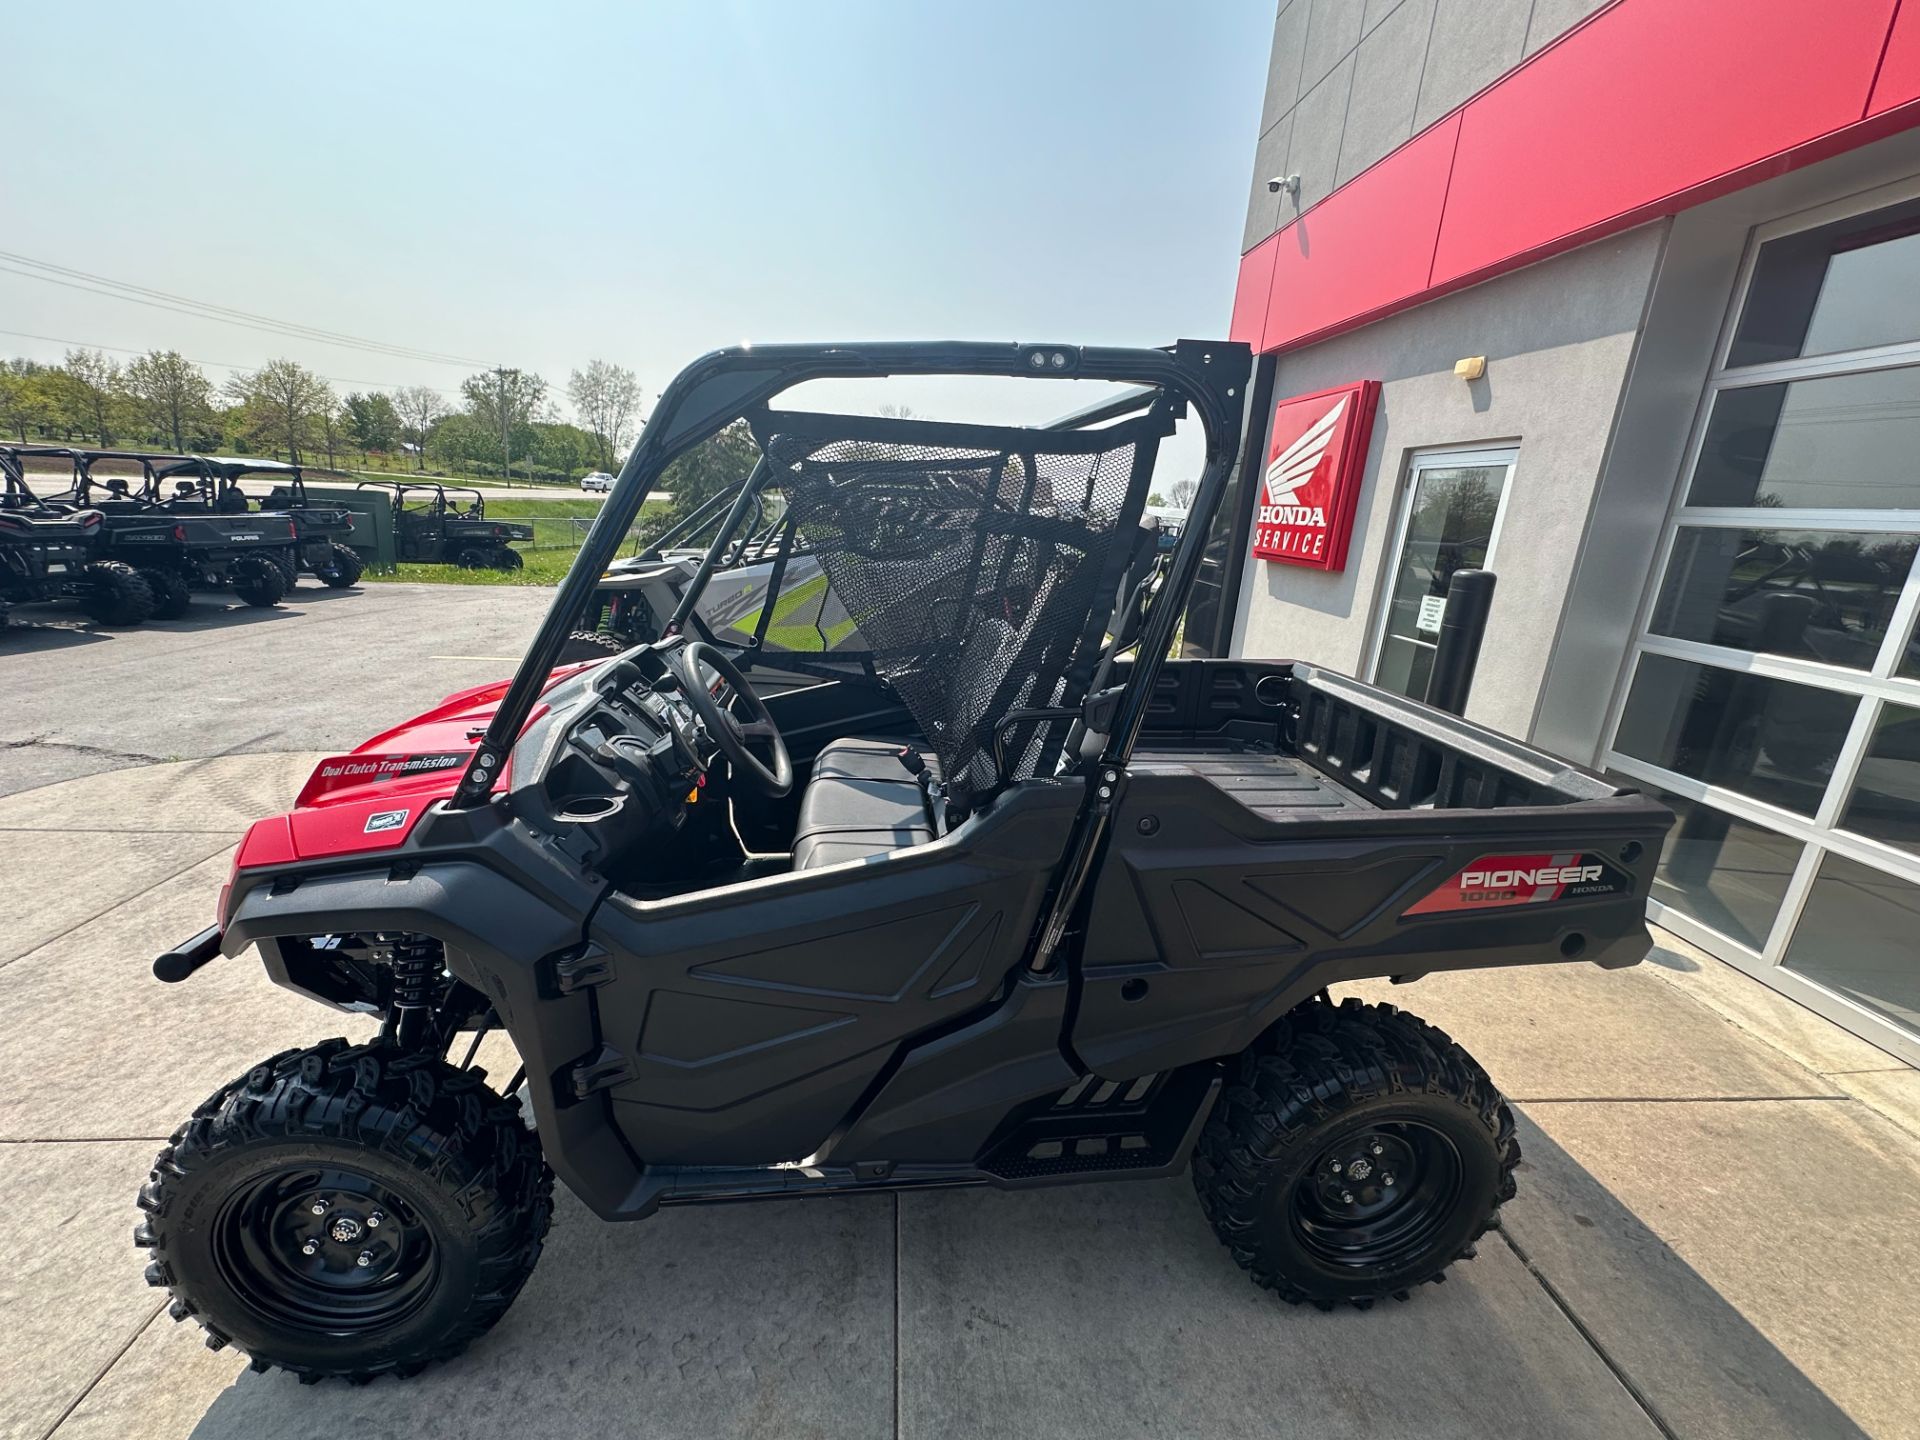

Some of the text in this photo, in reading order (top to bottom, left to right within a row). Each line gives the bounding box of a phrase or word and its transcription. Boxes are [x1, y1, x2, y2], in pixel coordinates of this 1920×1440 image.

[1258, 505, 1327, 527] HONDA
[231, 534, 260, 542] POLARIS
[1254, 529, 1324, 555] SERVICE
[321, 755, 457, 777] Dual Clutch Transmission
[1460, 865, 1603, 889] PIONEER
[1459, 891, 1517, 902] 1000
[1572, 885, 1615, 895] HONDA
